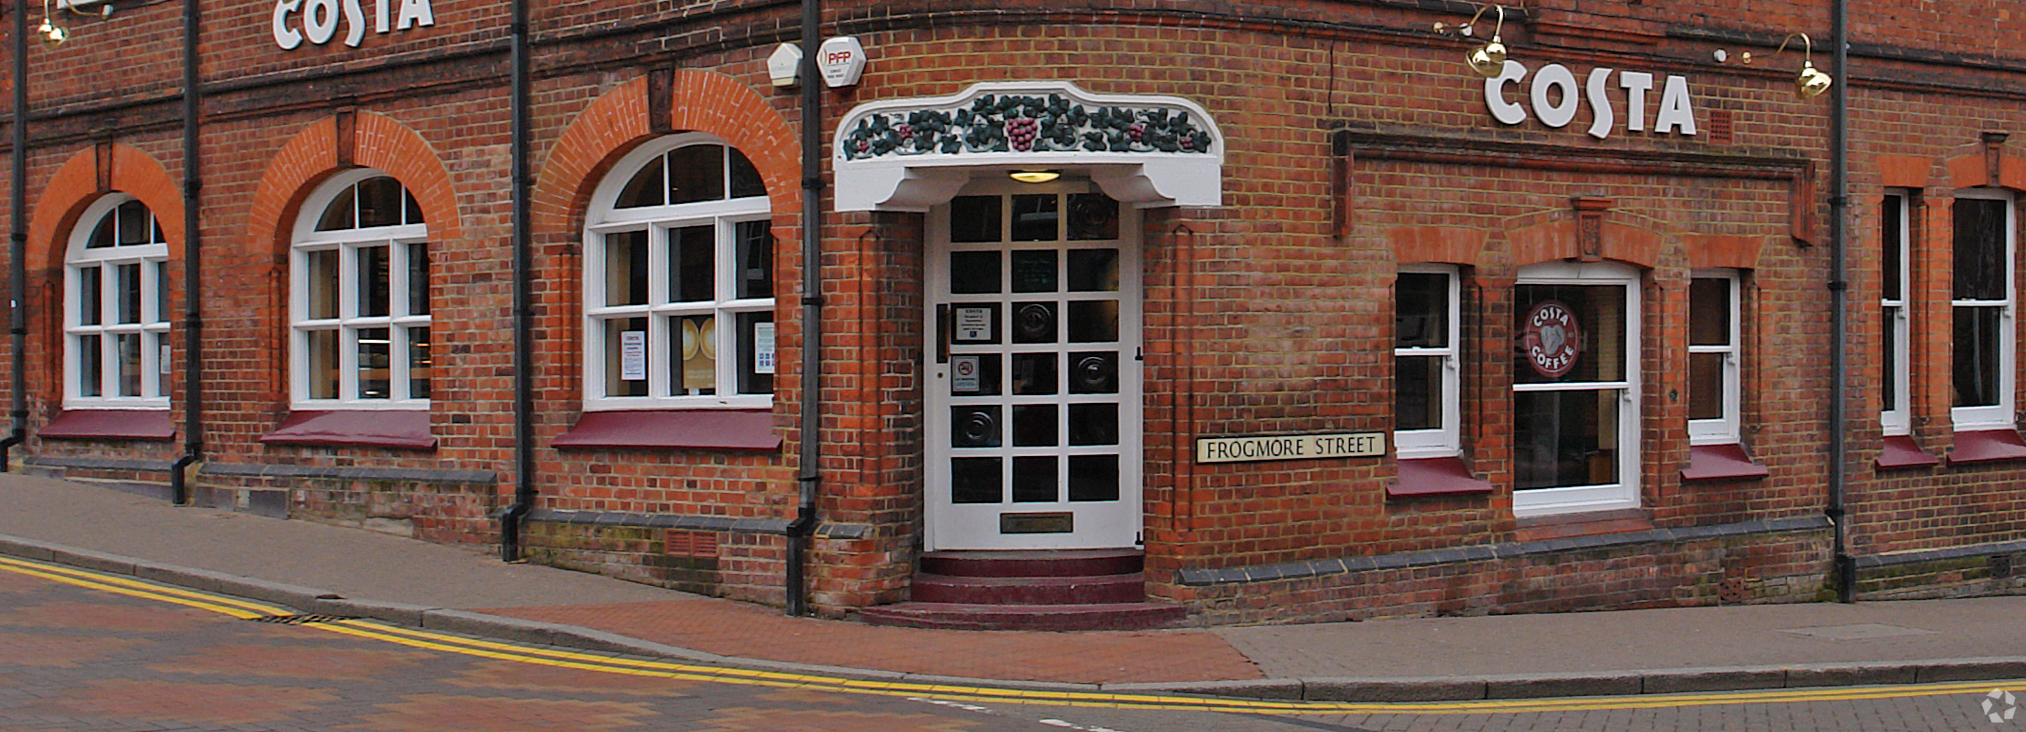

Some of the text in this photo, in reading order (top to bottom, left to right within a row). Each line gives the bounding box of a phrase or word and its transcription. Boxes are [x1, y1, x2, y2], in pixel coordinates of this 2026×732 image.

[828, 50, 851, 64] PFP
[1485, 60, 1697, 139] COSTA
[1533, 307, 1569, 327] COSTA
[1531, 345, 1574, 369] COFFEE
[1207, 436, 1376, 459] FROGMORE STREET
